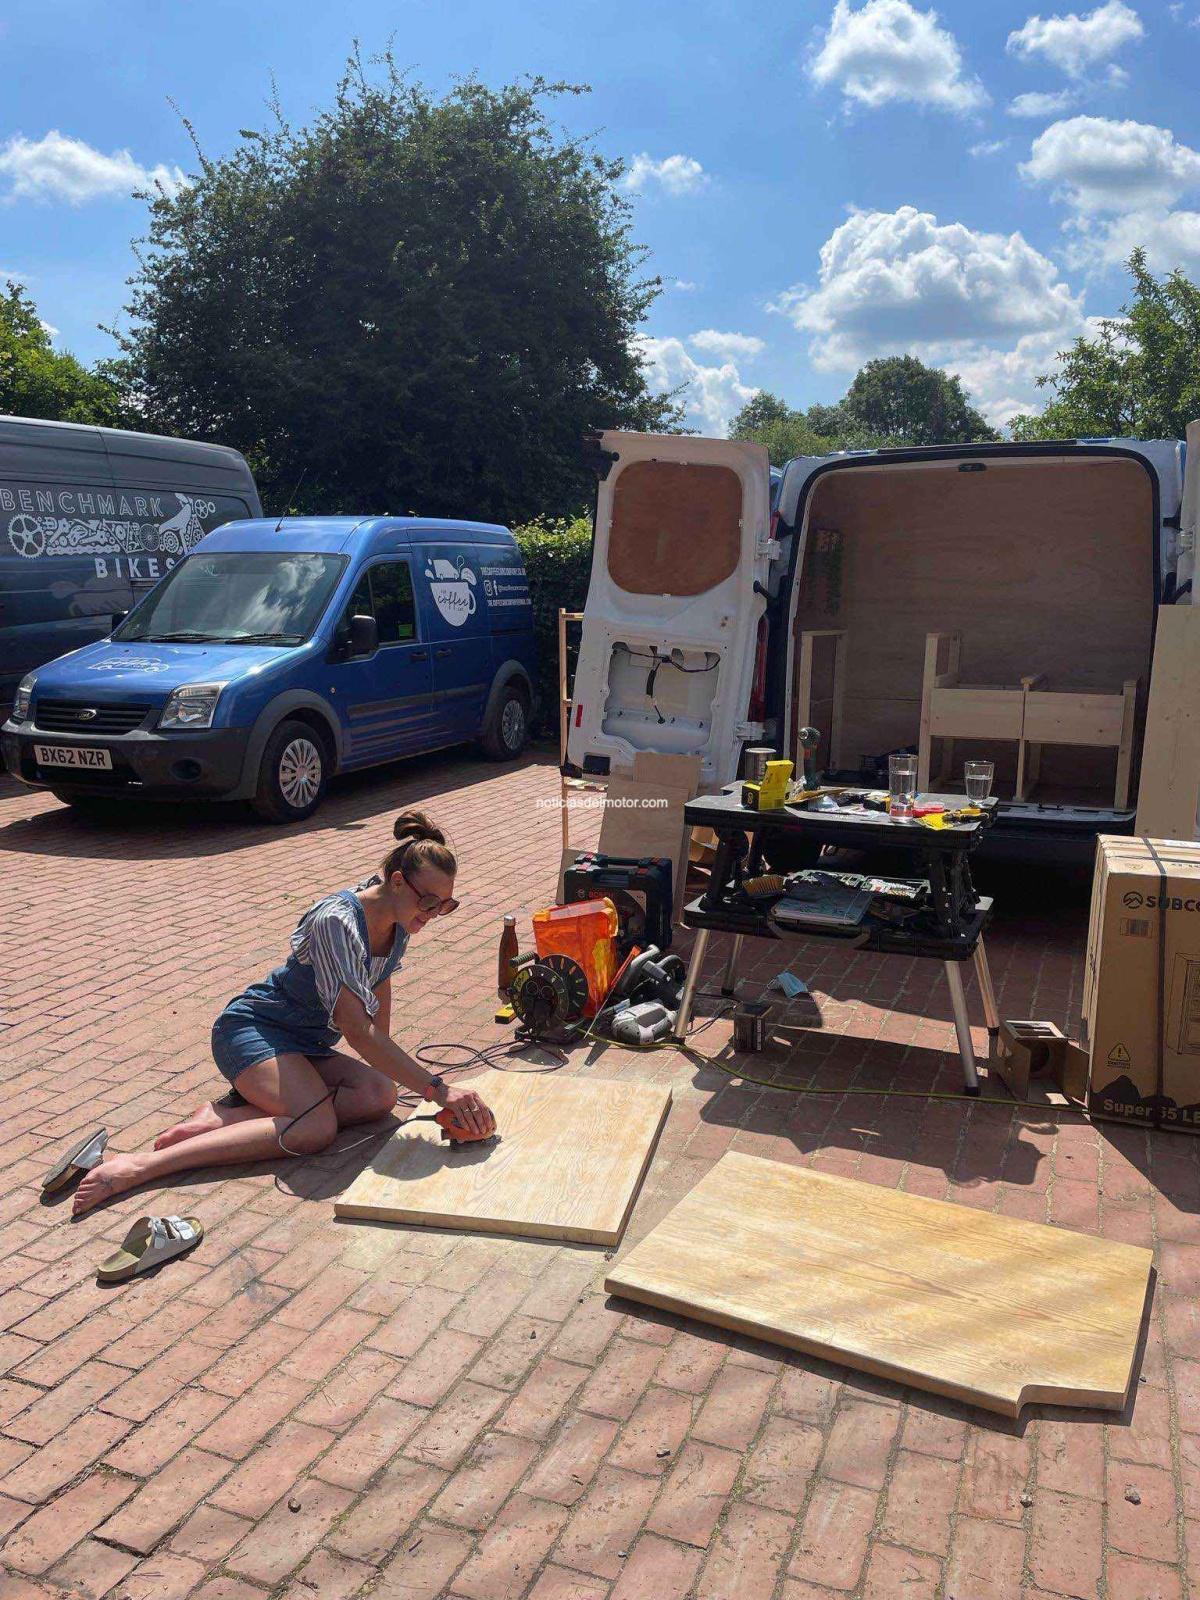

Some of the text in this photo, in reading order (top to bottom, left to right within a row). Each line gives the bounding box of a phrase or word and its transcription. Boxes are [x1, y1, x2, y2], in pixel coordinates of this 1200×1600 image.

[0, 489, 164, 518] BENCHMARK
[41, 747, 105, 767] BX62 NZR
[1103, 1098, 1153, 1120] Super
